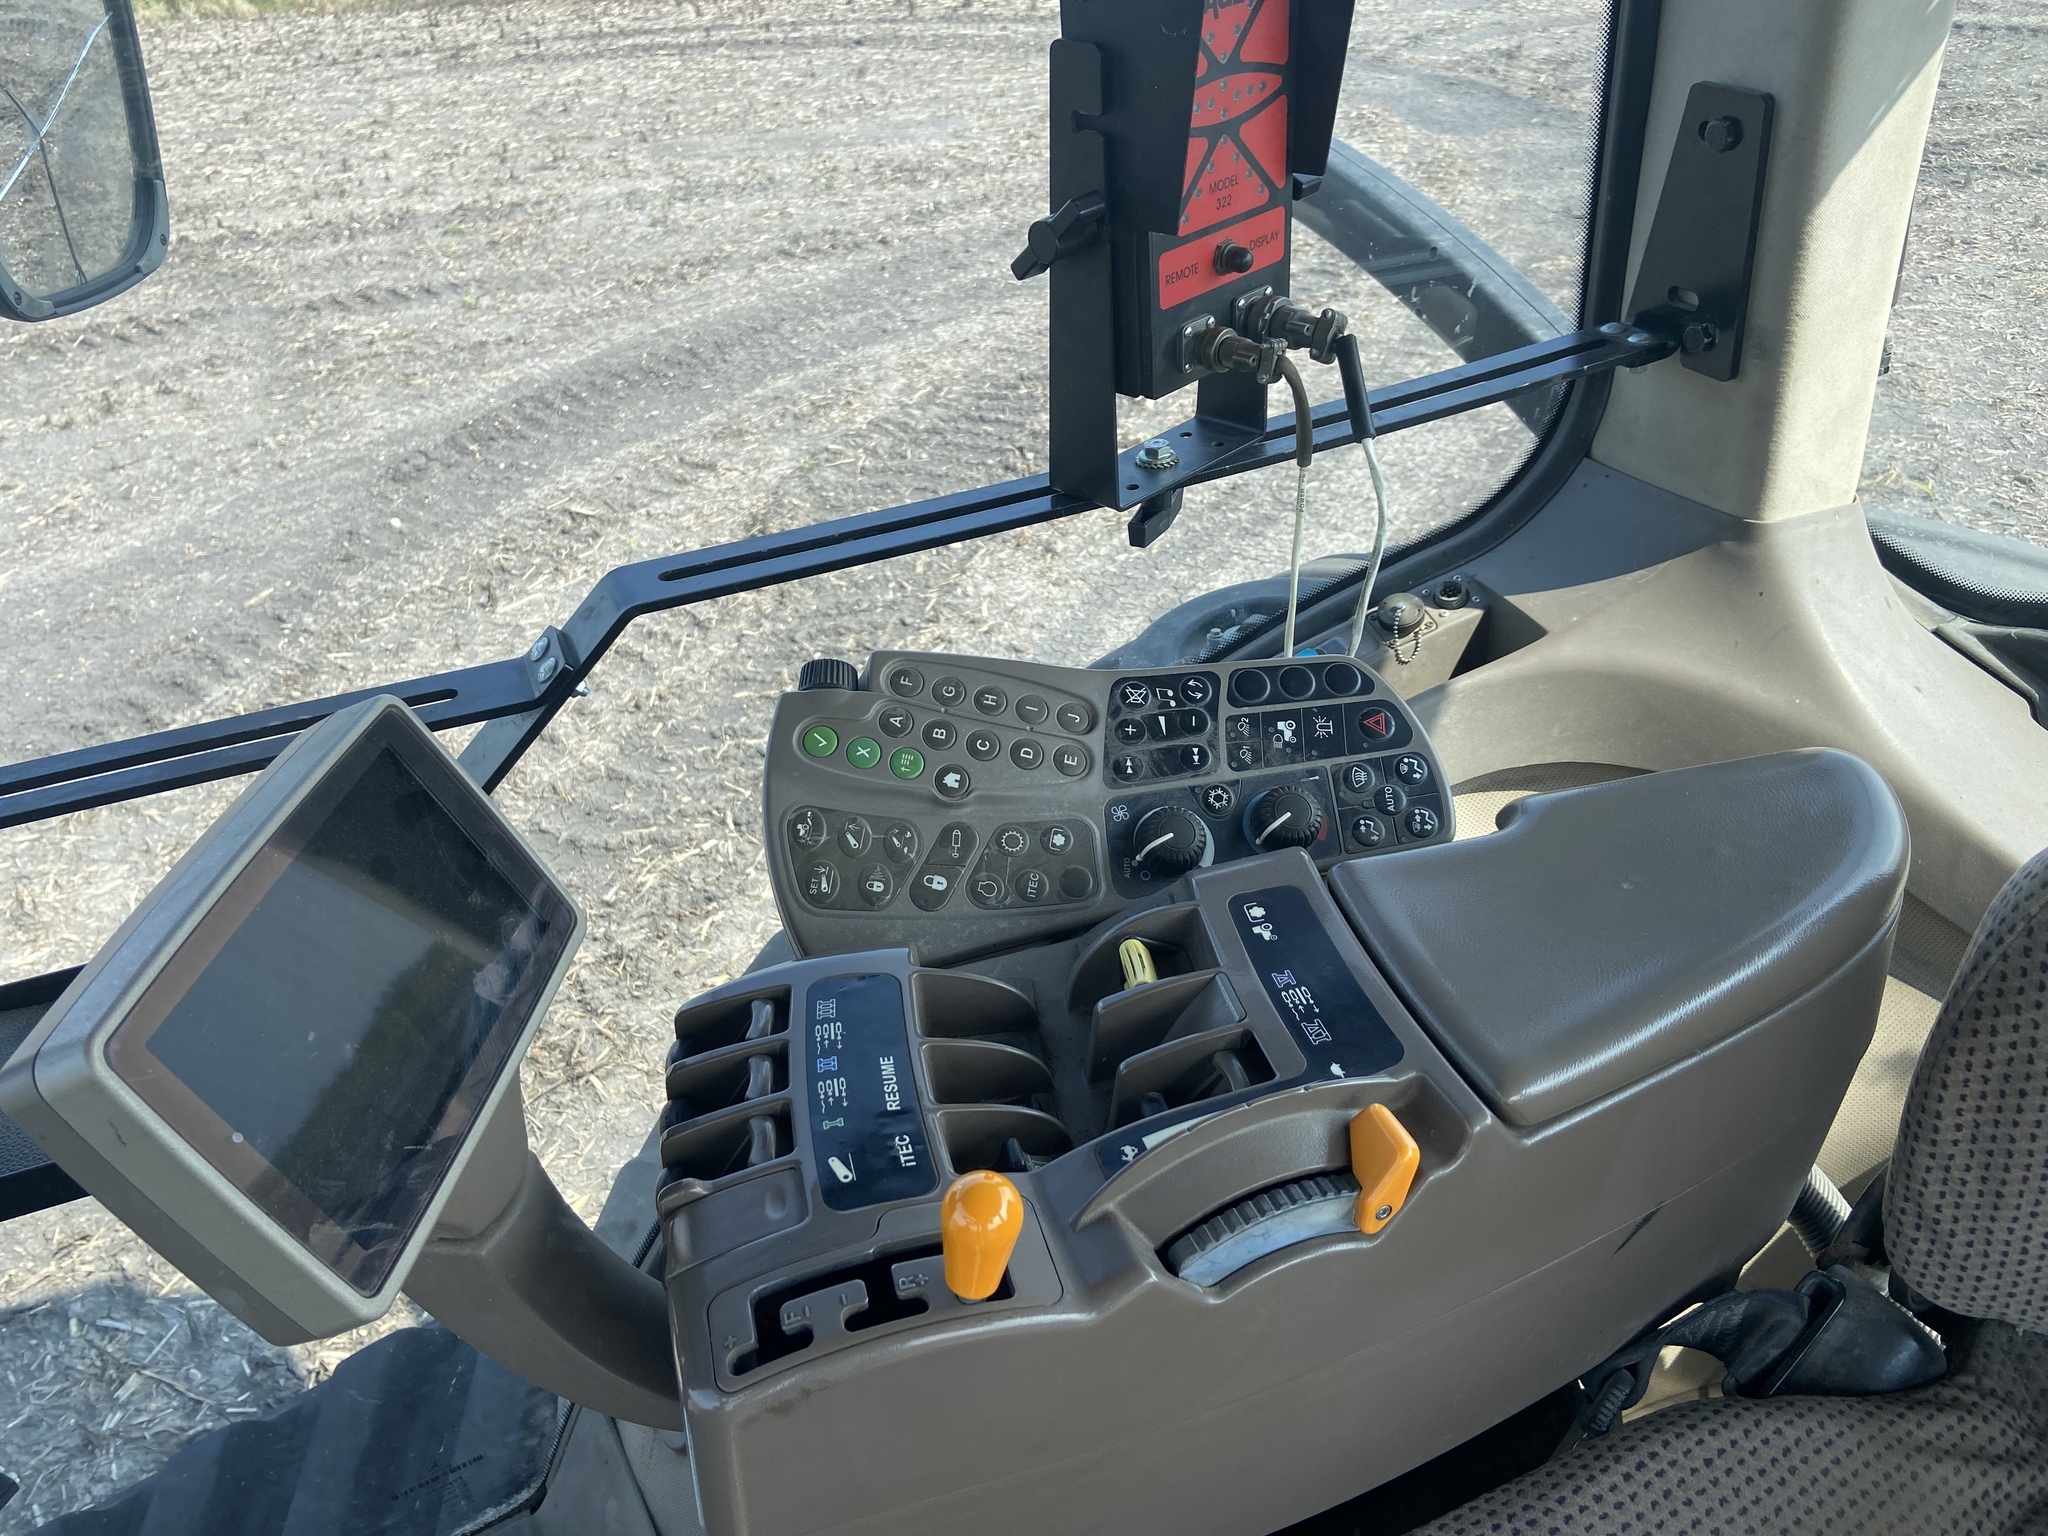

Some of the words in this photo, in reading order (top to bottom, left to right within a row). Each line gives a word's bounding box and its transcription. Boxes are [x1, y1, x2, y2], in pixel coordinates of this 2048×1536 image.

[1208, 174, 1239, 195] MODEL
[1216, 194, 1232, 210] 322
[1165, 263, 1199, 286] REMOTE
[1249, 229, 1280, 251] DISPLAY
[899, 676, 914, 687] F
[942, 685, 956, 698] G
[983, 694, 998, 707] H
[889, 715, 904, 728] A
[1067, 712, 1081, 723] J
[932, 728, 947, 740] B
[976, 739, 991, 752] C
[1020, 747, 1035, 760] D
[1064, 754, 1078, 767] E
[1384, 786, 1396, 812] AUTO
[1123, 857, 1131, 879] AUTO
[809, 876, 819, 895] SET
[1026, 873, 1040, 899] iTEC
[879, 1055, 901, 1111] RESUME
[895, 1134, 917, 1167] iTEC
